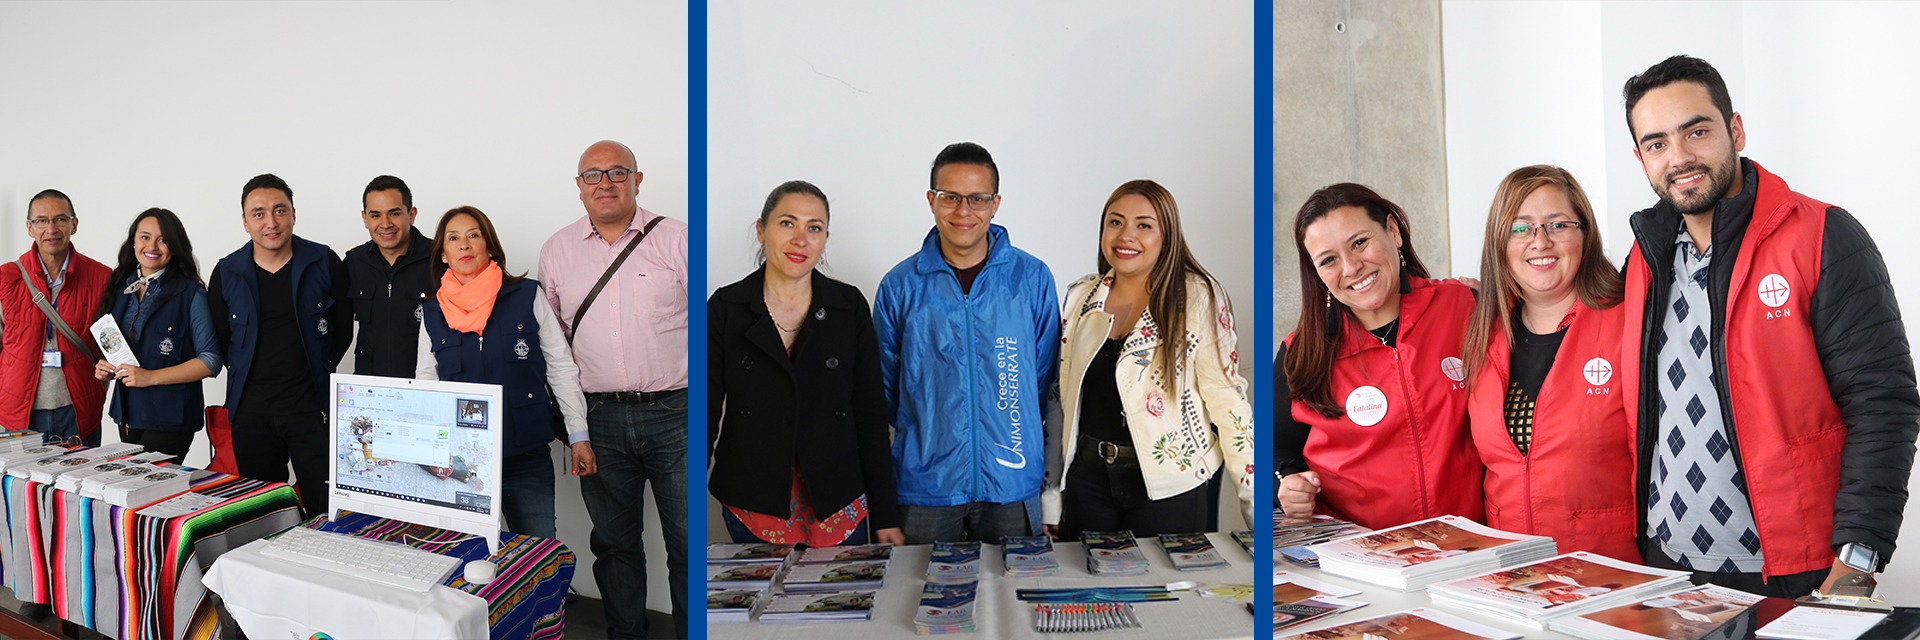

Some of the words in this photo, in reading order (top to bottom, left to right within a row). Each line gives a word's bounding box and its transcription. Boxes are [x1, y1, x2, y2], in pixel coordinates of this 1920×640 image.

[1766, 308, 1791, 320] ACN
[995, 337, 1005, 349] la
[998, 351, 1006, 368] en
[997, 372, 1008, 410] Crece
[1586, 387, 1610, 395] ACN
[995, 336, 1026, 469] UNIMONSERRATE
[1353, 403, 1382, 412] Catalina
[334, 490, 351, 498] Lenovo
